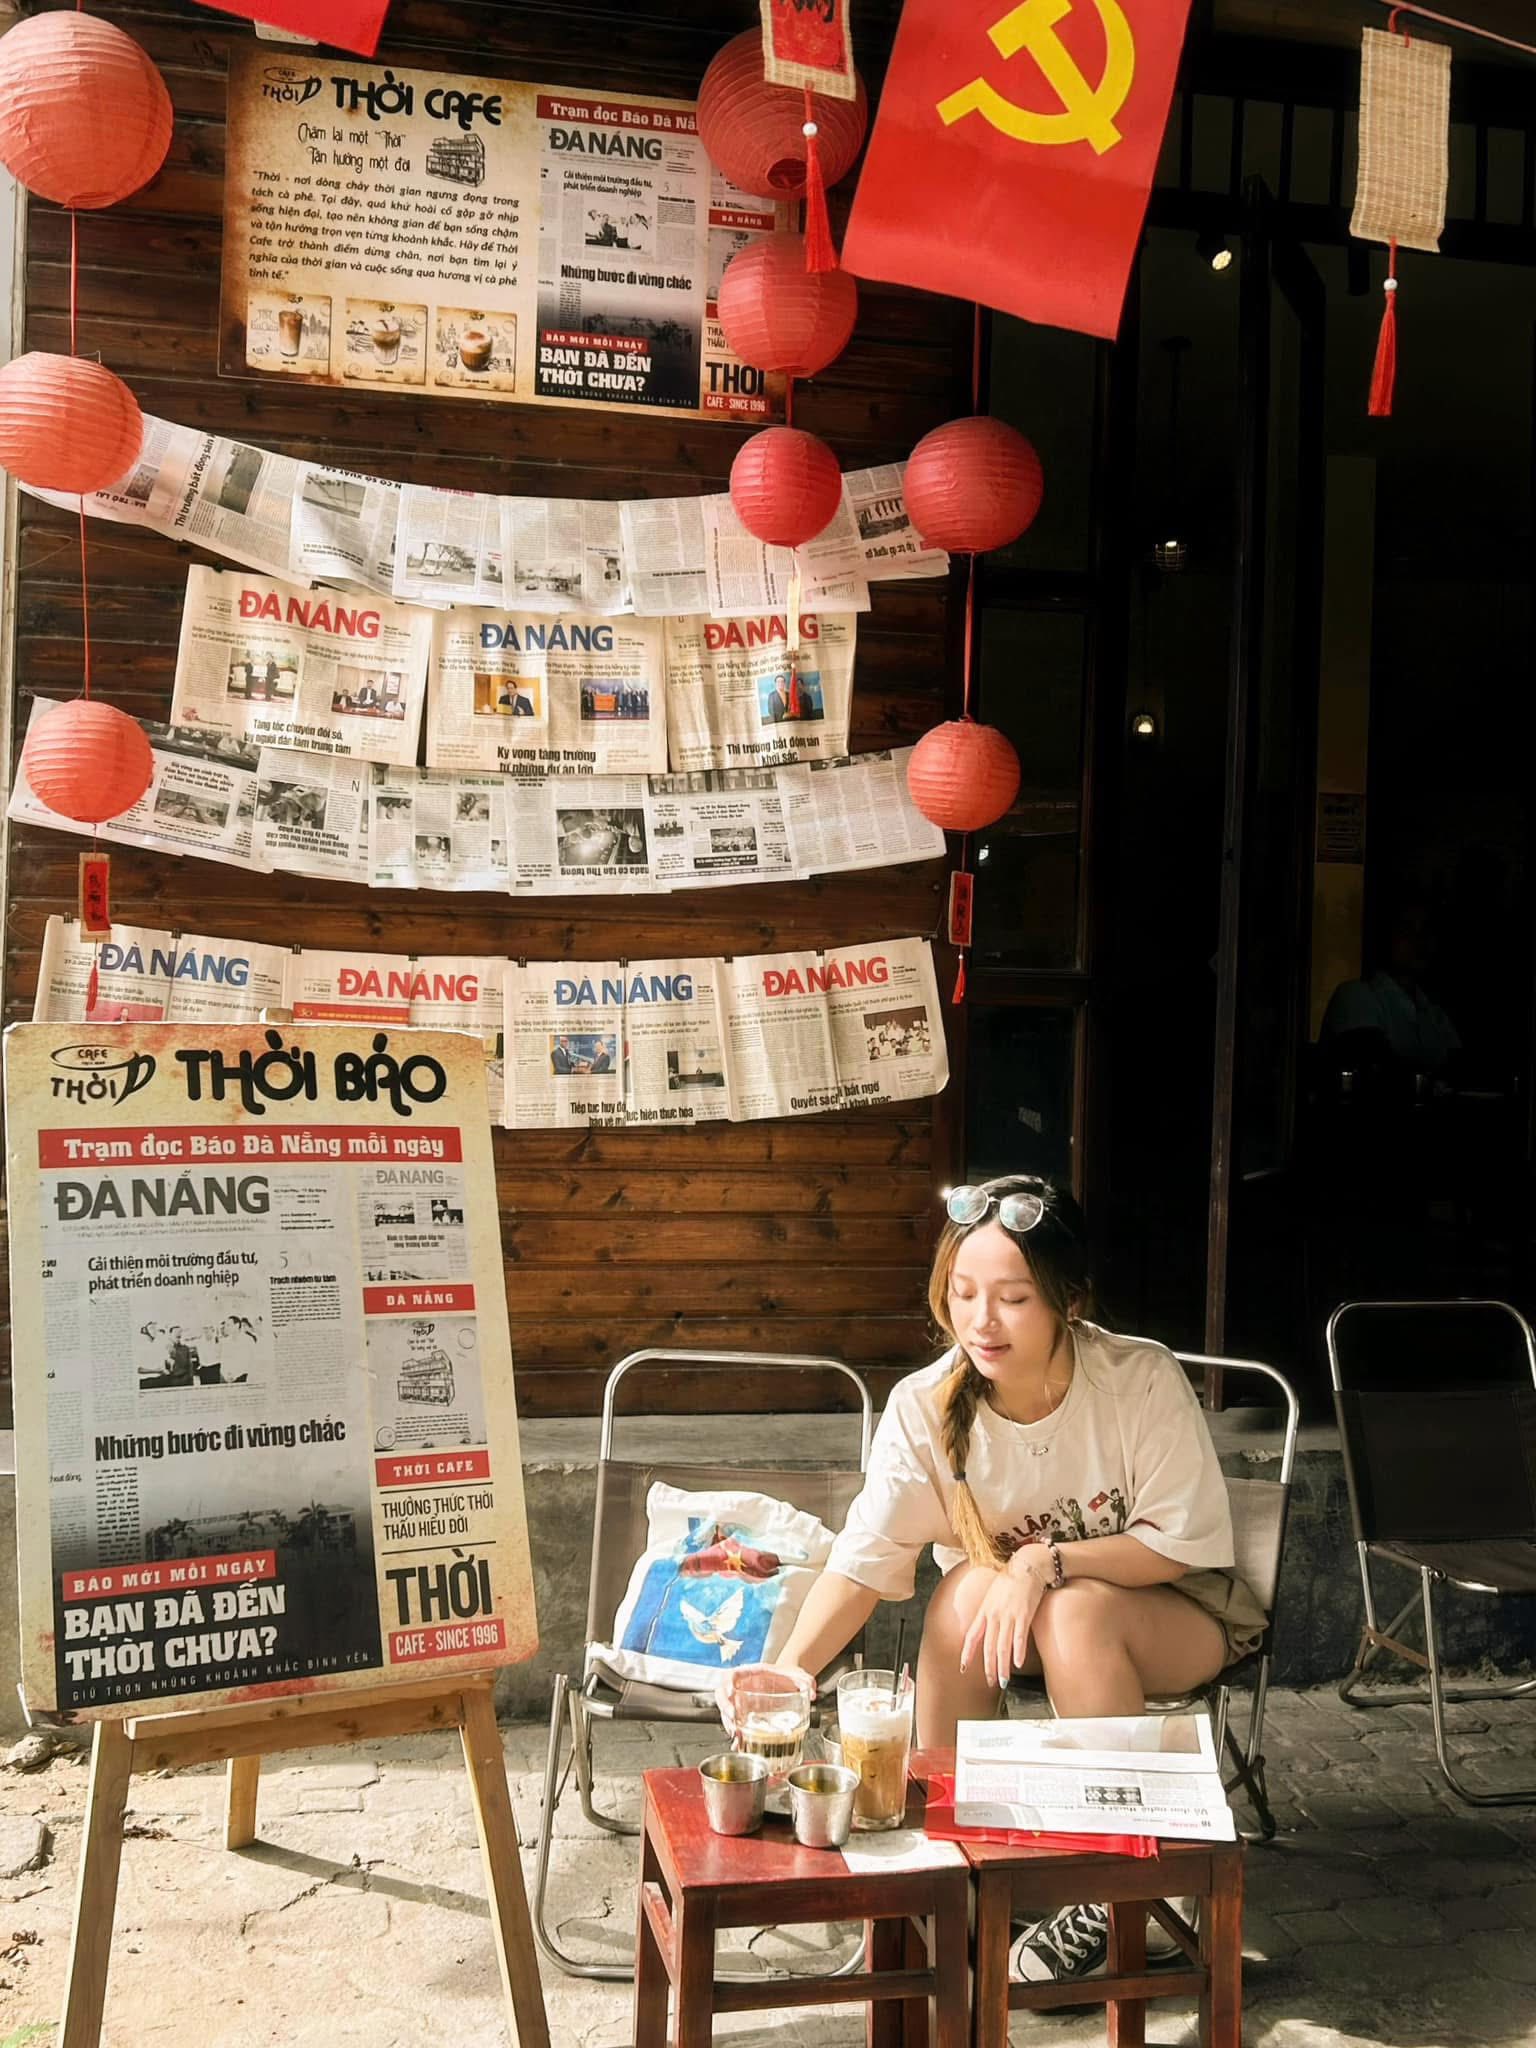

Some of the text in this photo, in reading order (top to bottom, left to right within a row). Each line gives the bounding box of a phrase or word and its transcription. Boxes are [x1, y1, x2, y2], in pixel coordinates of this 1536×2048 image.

[331, 70, 501, 130] THỜI CAFE
[551, 103, 589, 120] Trạm
[594, 106, 618, 122] đọc
[622, 110, 648, 124] Báo
[653, 114, 671, 127] Đà
[333, 126, 342, 141] lại
[350, 130, 368, 145] một
[549, 127, 585, 153] ĐÀ
[307, 146, 410, 173] Tận hưởng một đời
[561, 264, 691, 290] Những bước đi vững chắc
[540, 348, 651, 372] BẠN ĐÃ ĐẾN
[540, 367, 645, 391] THỜI CHƯA?
[707, 396, 724, 408] CAFE
[729, 397, 748, 410] SINCE
[750, 398, 765, 412] 1996
[78, 1048, 108, 1059] CAFE
[175, 1029, 447, 1116] THỜI BÁO
[51, 1072, 116, 1104] THỜI
[64, 1131, 444, 1163] Trạm đọc Báo Đà Nẵng mỗi ngày
[53, 1174, 129, 1221] ĐÀ
[132, 1169, 270, 1218] NẴNG
[88, 1250, 258, 1272] Cải thiện môi trường đầu tư,
[88, 1270, 239, 1294] phát triển doanh nghiệp
[386, 1292, 406, 1306] ĐÀ
[94, 1414, 346, 1461] Những bước đi vững chắc
[393, 1459, 474, 1477] THỜI CAFE
[382, 1490, 494, 1519] THƯỞNG THỨC THỜI
[383, 1512, 468, 1540] THẤU HIỂU ĐỜI
[72, 1556, 267, 1594] BÁO MỚI MỖI NGÀY
[386, 1547, 492, 1626] THỜI
[64, 1577, 286, 1643] BẠN ĐÃ ĐẾN
[64, 1625, 279, 1681] THỜI CHƯA?
[396, 1632, 426, 1657] CAFE
[435, 1629, 470, 1652] SINCE
[472, 1624, 498, 1646] 1996
[107, 1683, 142, 1698] TRỌN
